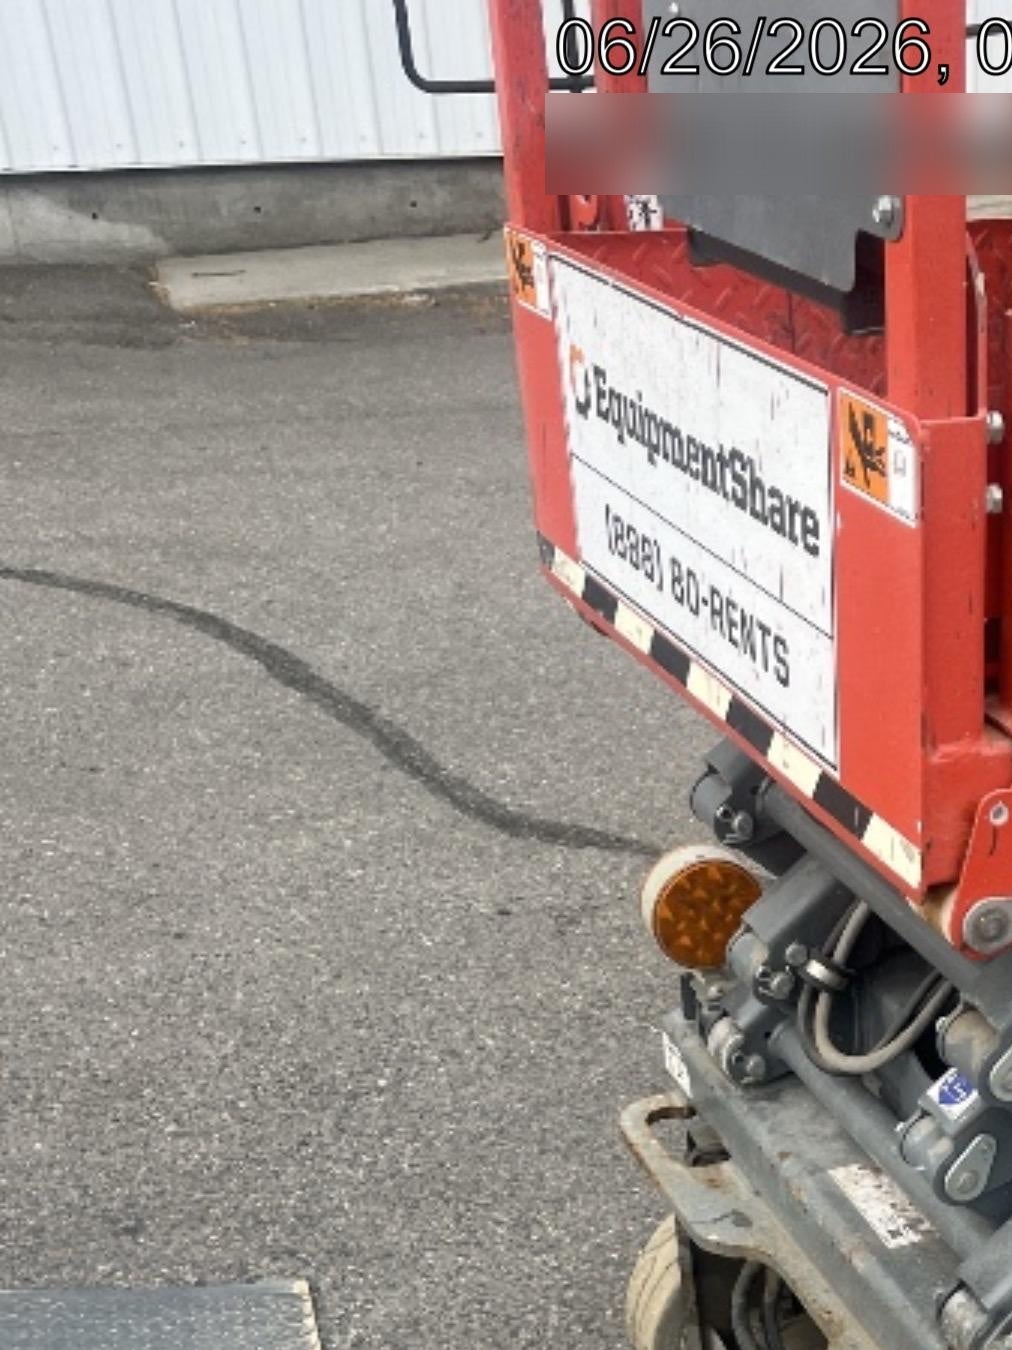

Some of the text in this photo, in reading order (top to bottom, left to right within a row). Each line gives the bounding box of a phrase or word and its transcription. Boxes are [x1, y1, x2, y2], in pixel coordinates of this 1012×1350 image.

[593, 365, 821, 558] EquipmentShare
[604, 503, 790, 688] (888) 80-RENTS
